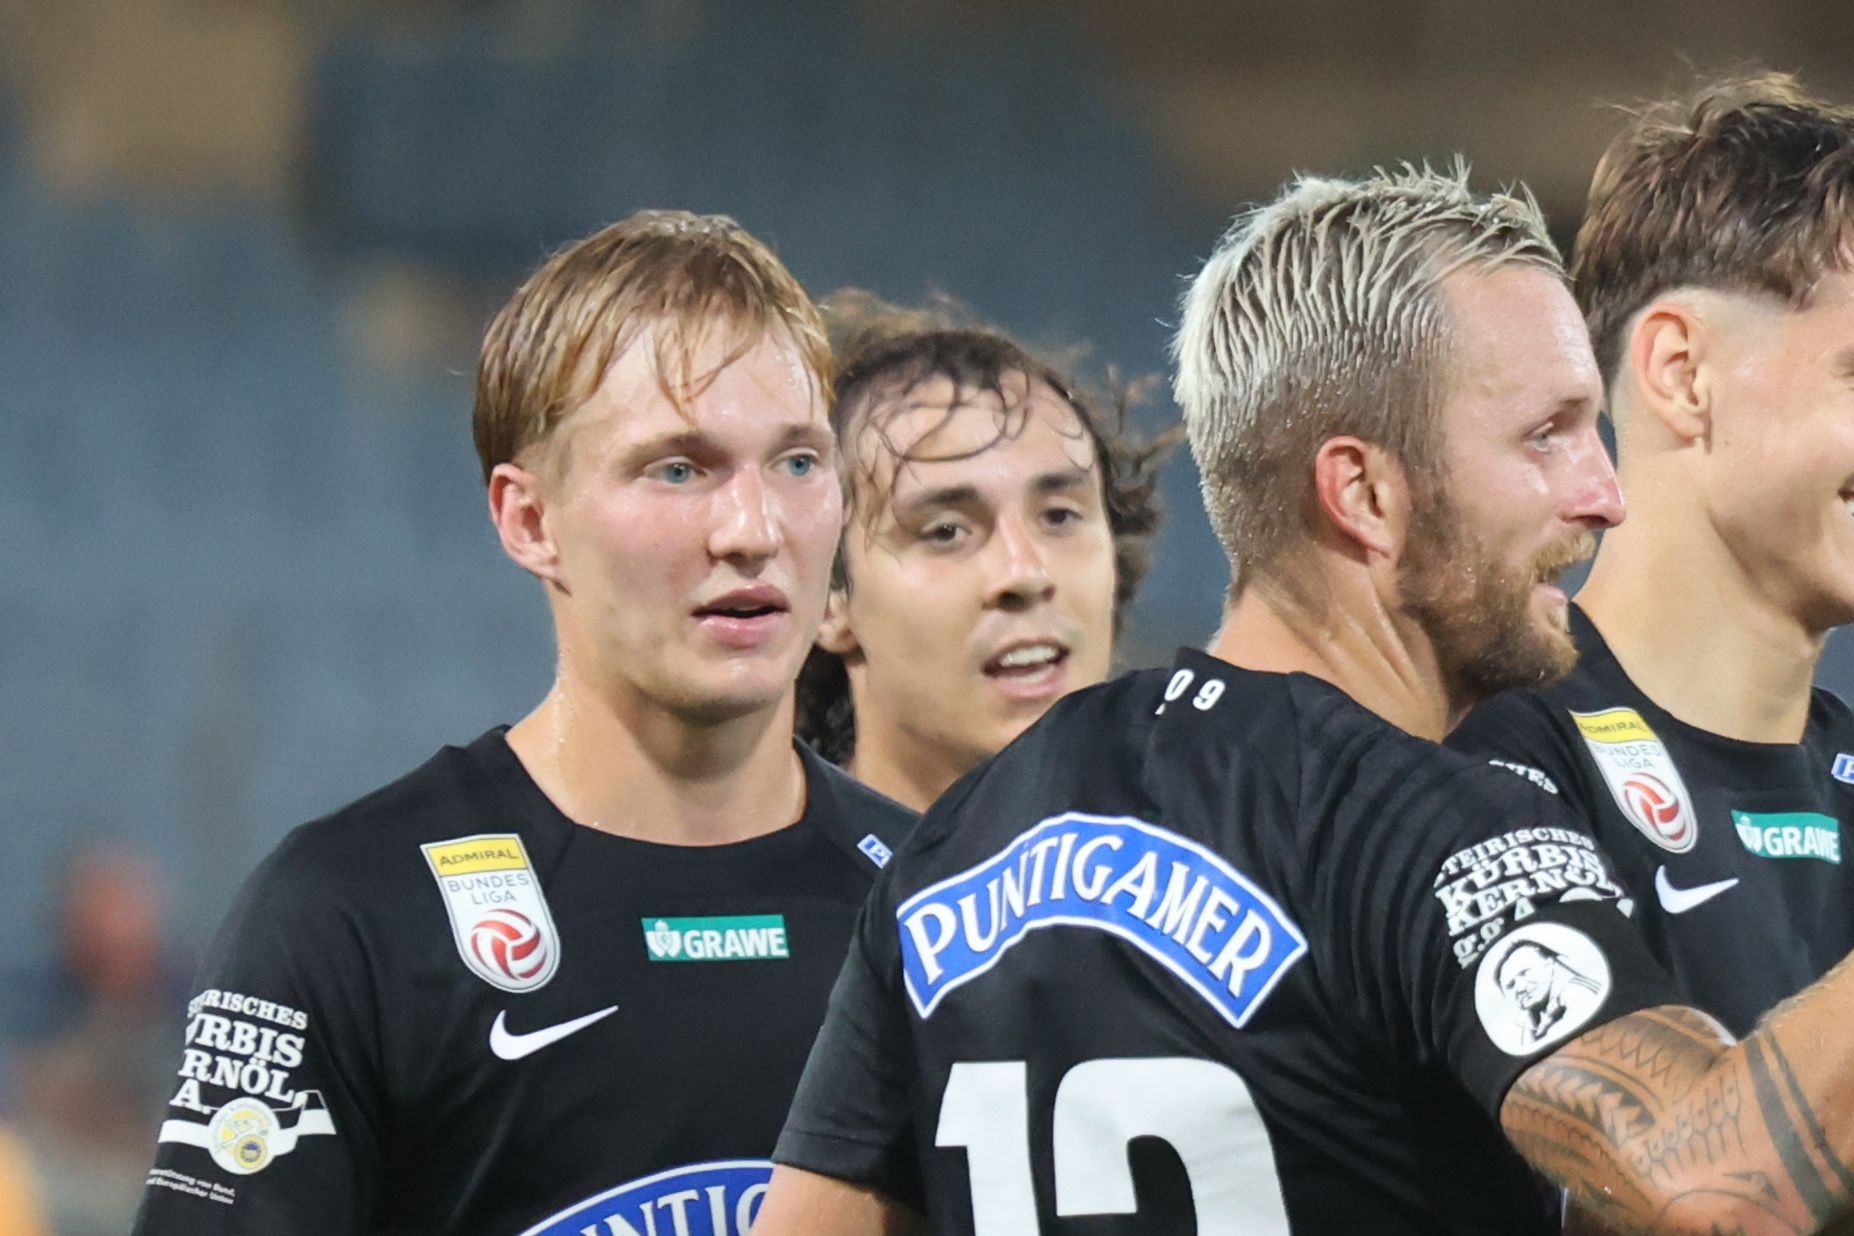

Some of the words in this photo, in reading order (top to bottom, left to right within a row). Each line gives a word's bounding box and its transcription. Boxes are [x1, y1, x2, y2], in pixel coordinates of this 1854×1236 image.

[1614, 757, 1656, 770] LIGA
[439, 848, 520, 867] ADMIRAL
[1763, 825, 1841, 863] GRAWE
[447, 873, 530, 892] BUNDES
[471, 890, 518, 905] LIGA
[904, 832, 1272, 999] PUNTIGAMER
[683, 927, 790, 959] GRAWE
[187, 989, 309, 1031] RISCHES
[185, 1013, 306, 1068] RBIS
[178, 1048, 295, 1104] RNÖL
